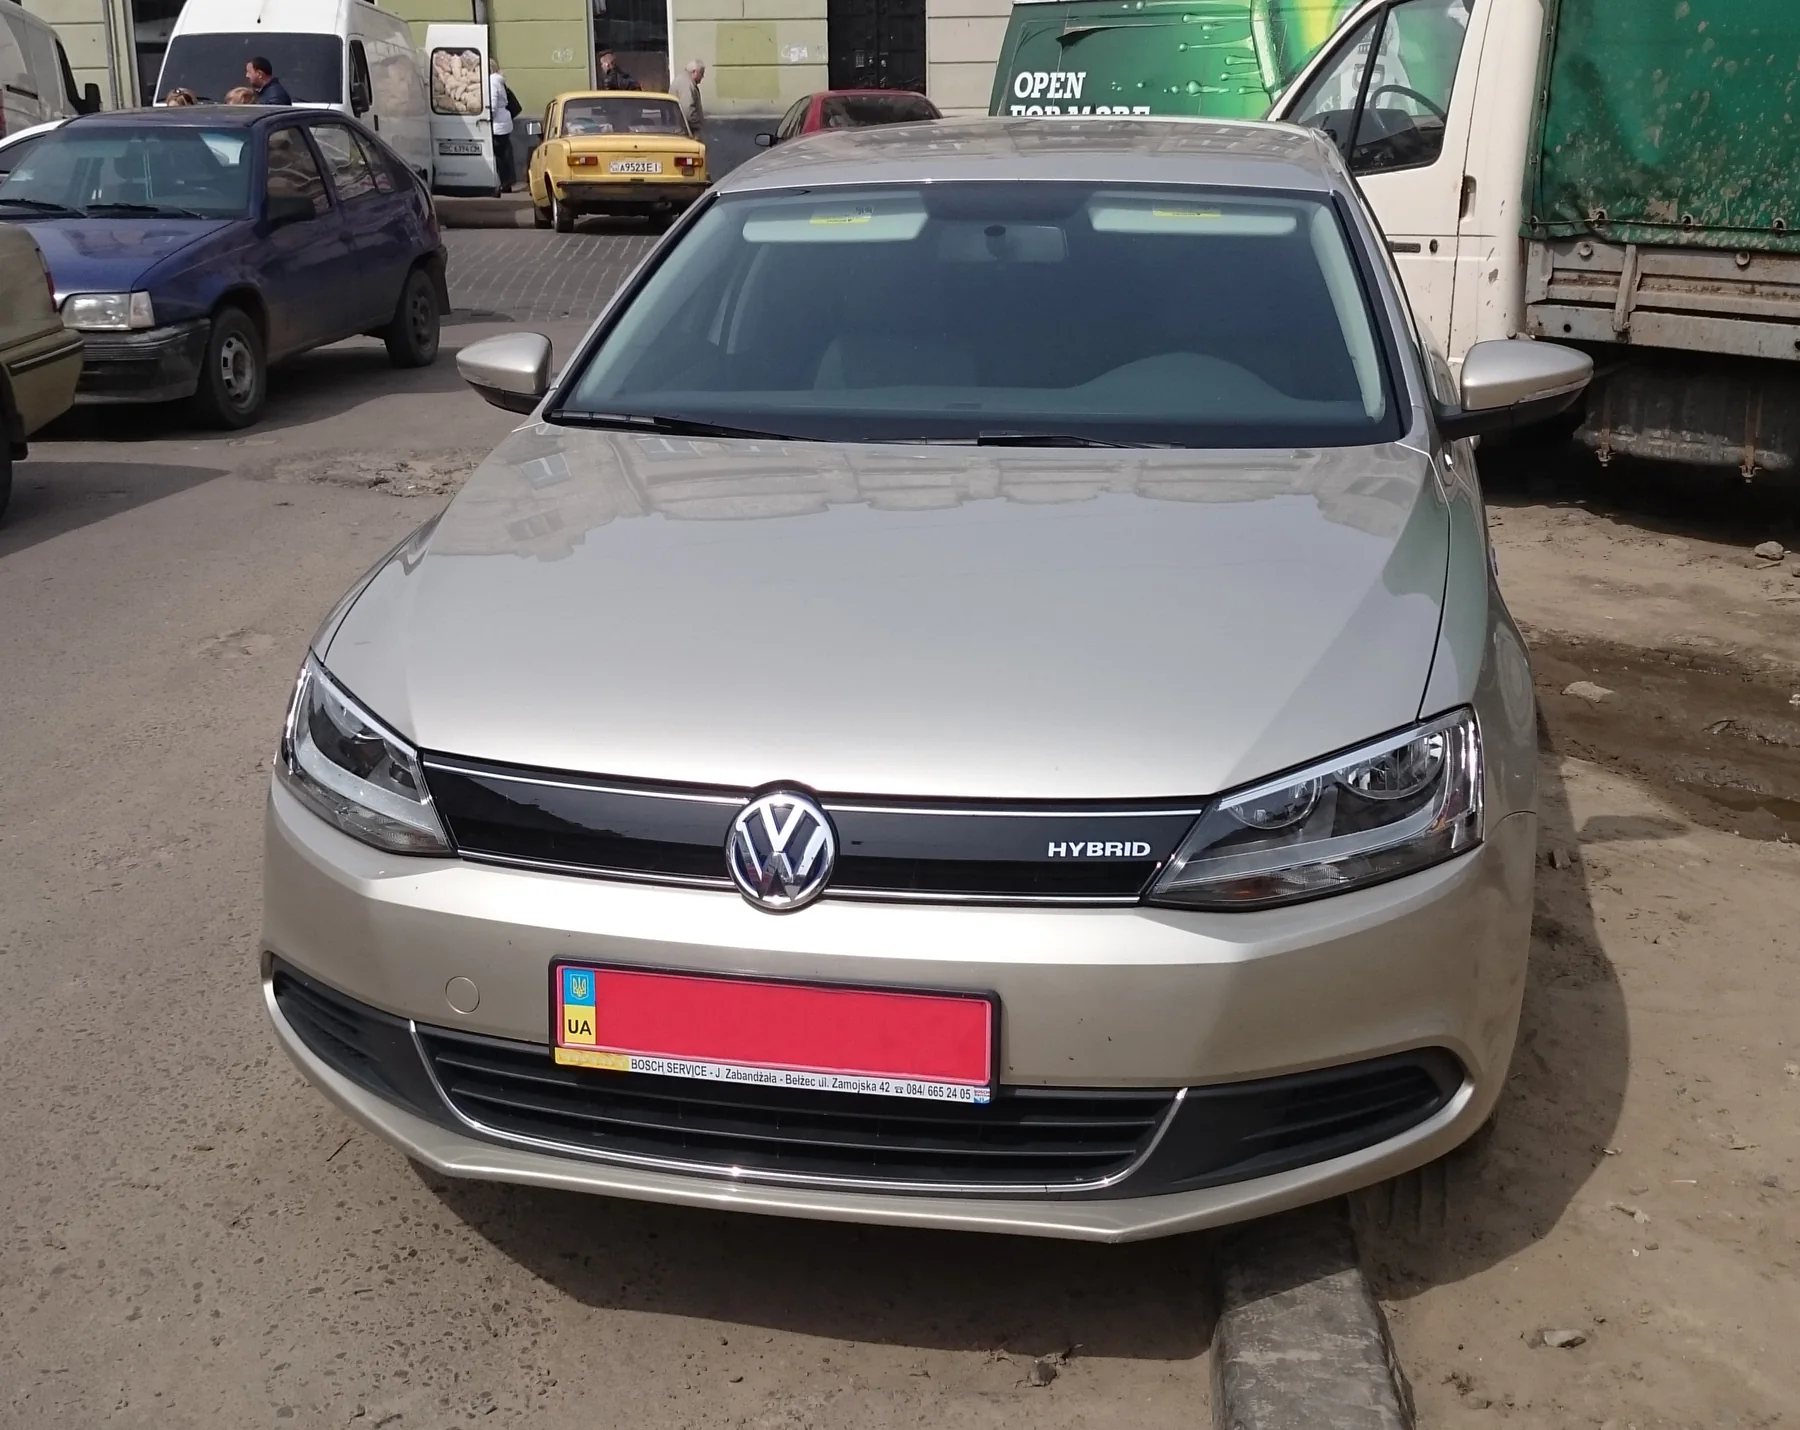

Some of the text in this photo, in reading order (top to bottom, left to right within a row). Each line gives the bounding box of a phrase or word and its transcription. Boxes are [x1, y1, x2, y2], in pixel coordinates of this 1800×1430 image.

[1014, 72, 1086, 98] OPEN
[1047, 841, 1151, 857] HYBRID
[568, 1019, 592, 1036] UA
[631, 1059, 664, 1072] BOSCH
[666, 1061, 707, 1077] SERVICE
[725, 1068, 777, 1084] Zabandżała
[785, 1073, 816, 1087] Bełżec
[832, 1077, 877, 1094] Zamojska
[879, 1081, 890, 1093] 42
[906, 1083, 925, 1096] 084/
[927, 1085, 944, 1098] 665
[946, 1086, 957, 1099] 24
[959, 1088, 971, 1100] 05
